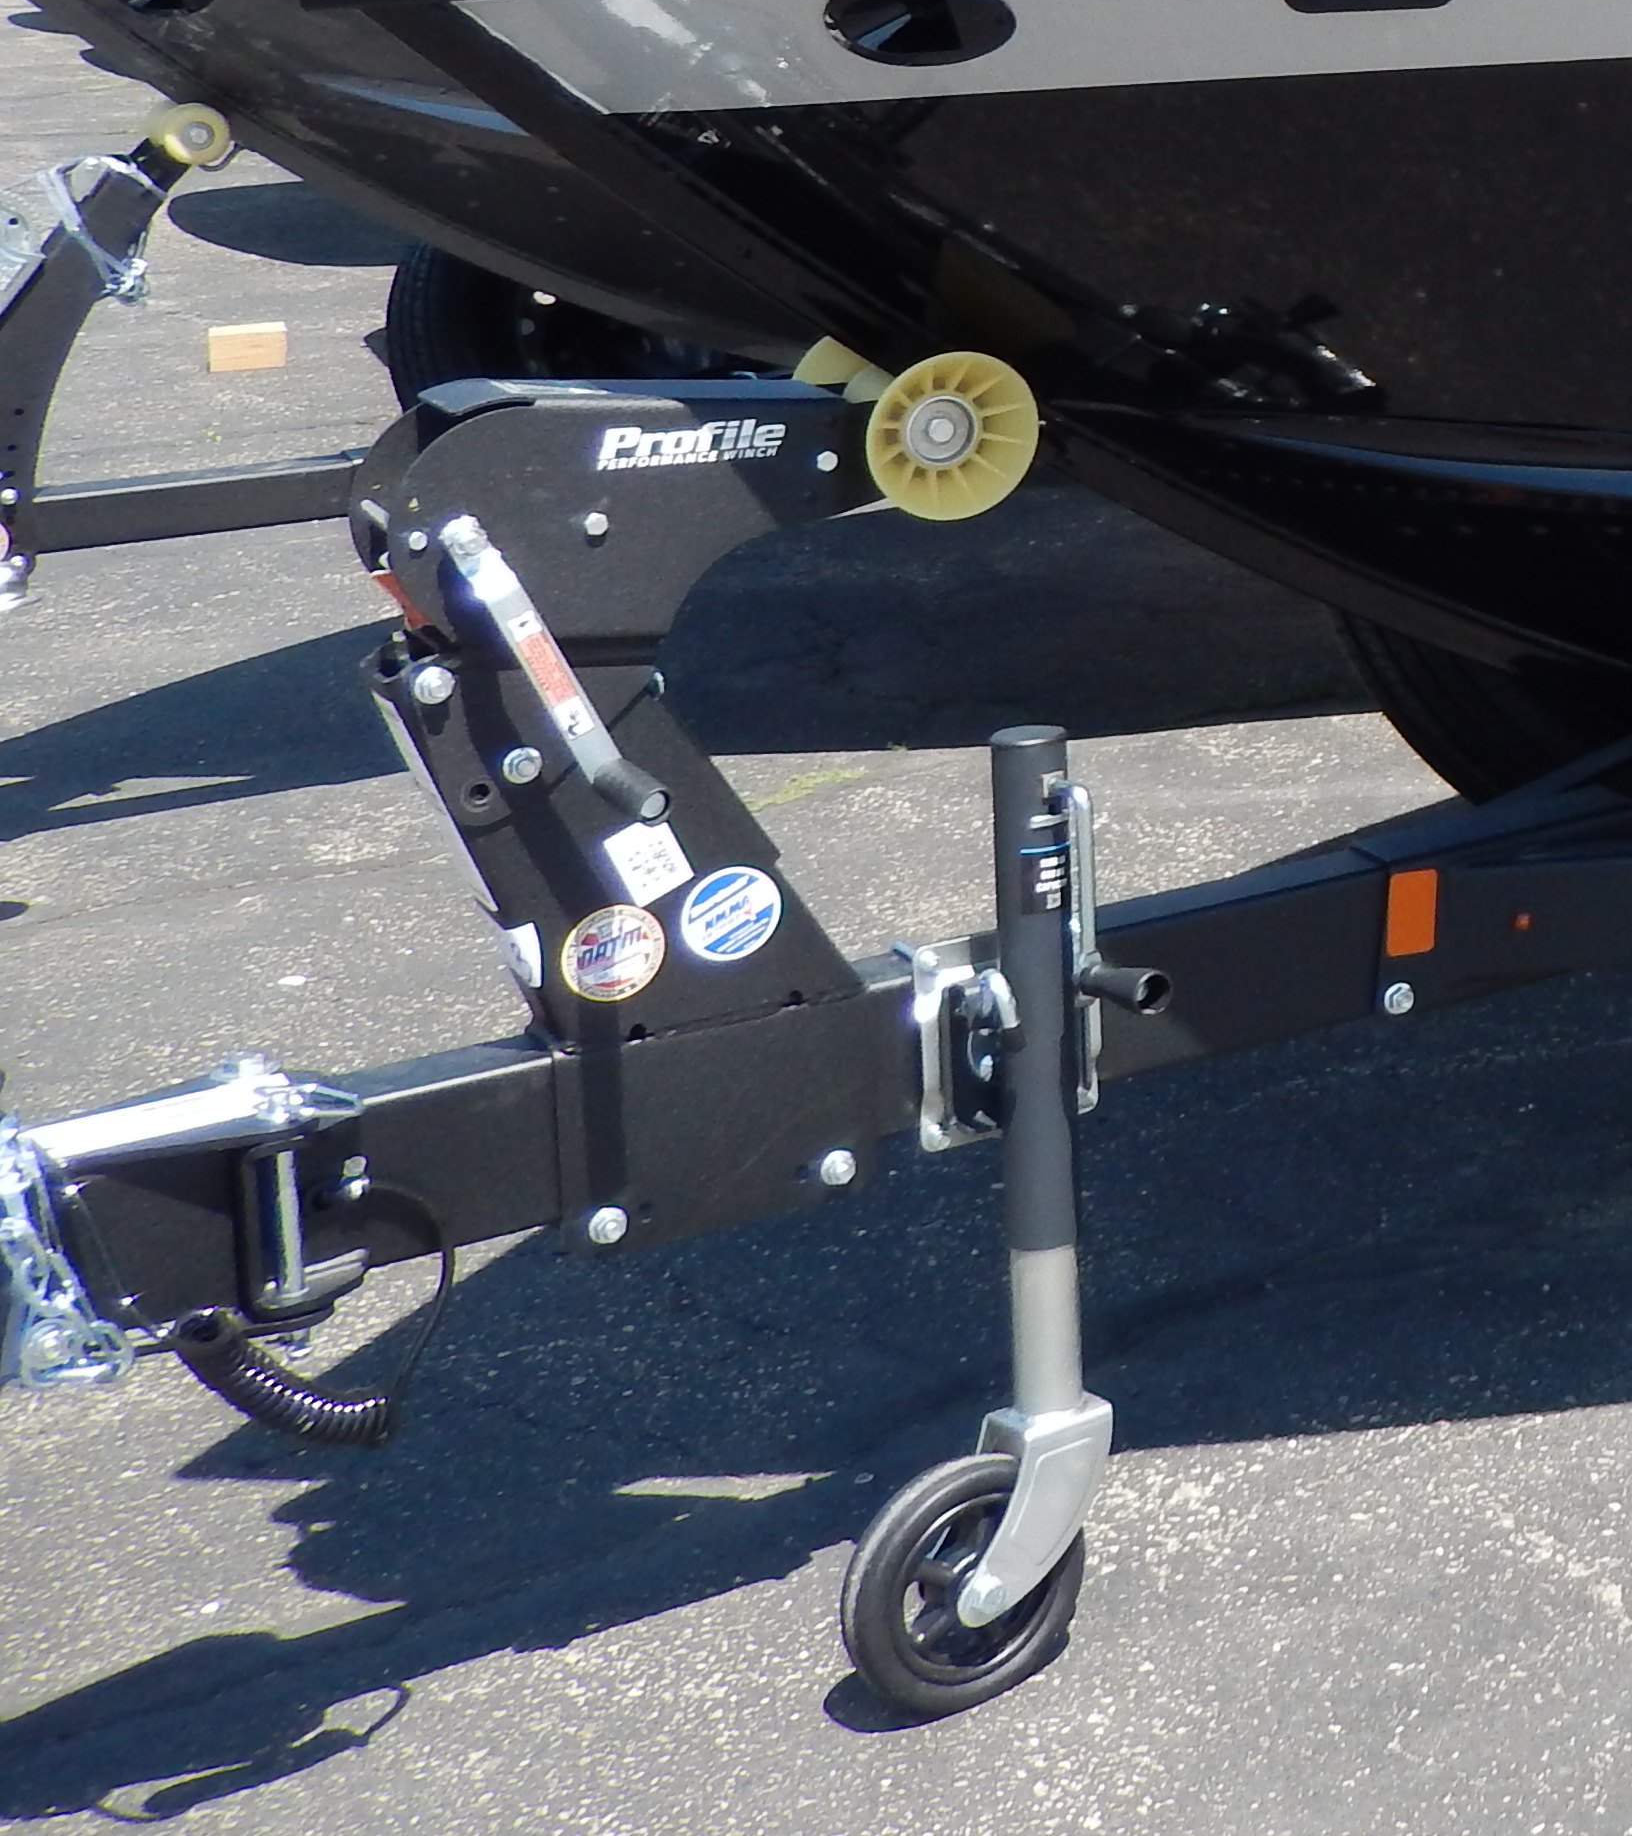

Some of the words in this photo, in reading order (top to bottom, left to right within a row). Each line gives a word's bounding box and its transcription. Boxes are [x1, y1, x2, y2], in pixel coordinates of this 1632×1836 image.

[598, 418, 787, 461] Profile
[597, 450, 718, 471] PERFORMANCE
[723, 445, 779, 461] WINCH
